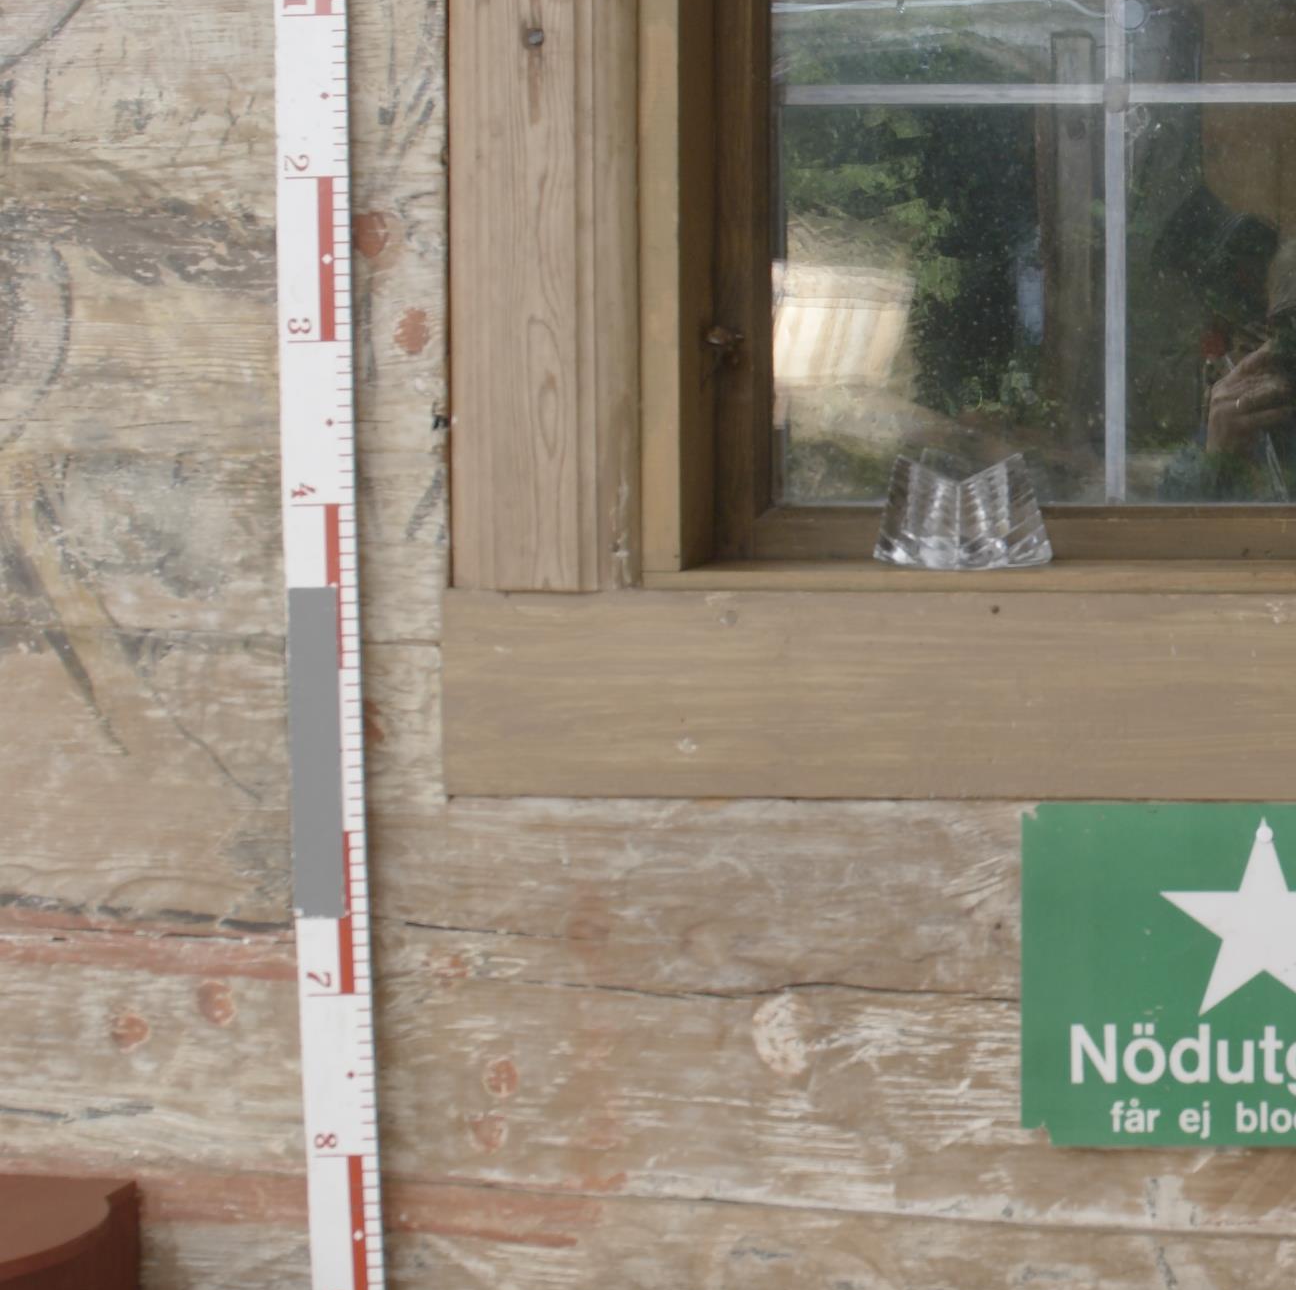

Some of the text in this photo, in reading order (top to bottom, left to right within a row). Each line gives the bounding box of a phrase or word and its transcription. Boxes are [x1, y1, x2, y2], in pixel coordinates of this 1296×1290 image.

[283, 154, 310, 172] 2
[287, 318, 312, 335] 3
[291, 482, 316, 499] 4
[306, 971, 332, 989] 7
[1110, 1097, 1161, 1134] får
[1178, 1100, 1211, 1140] ej
[314, 1133, 337, 1150] 8
